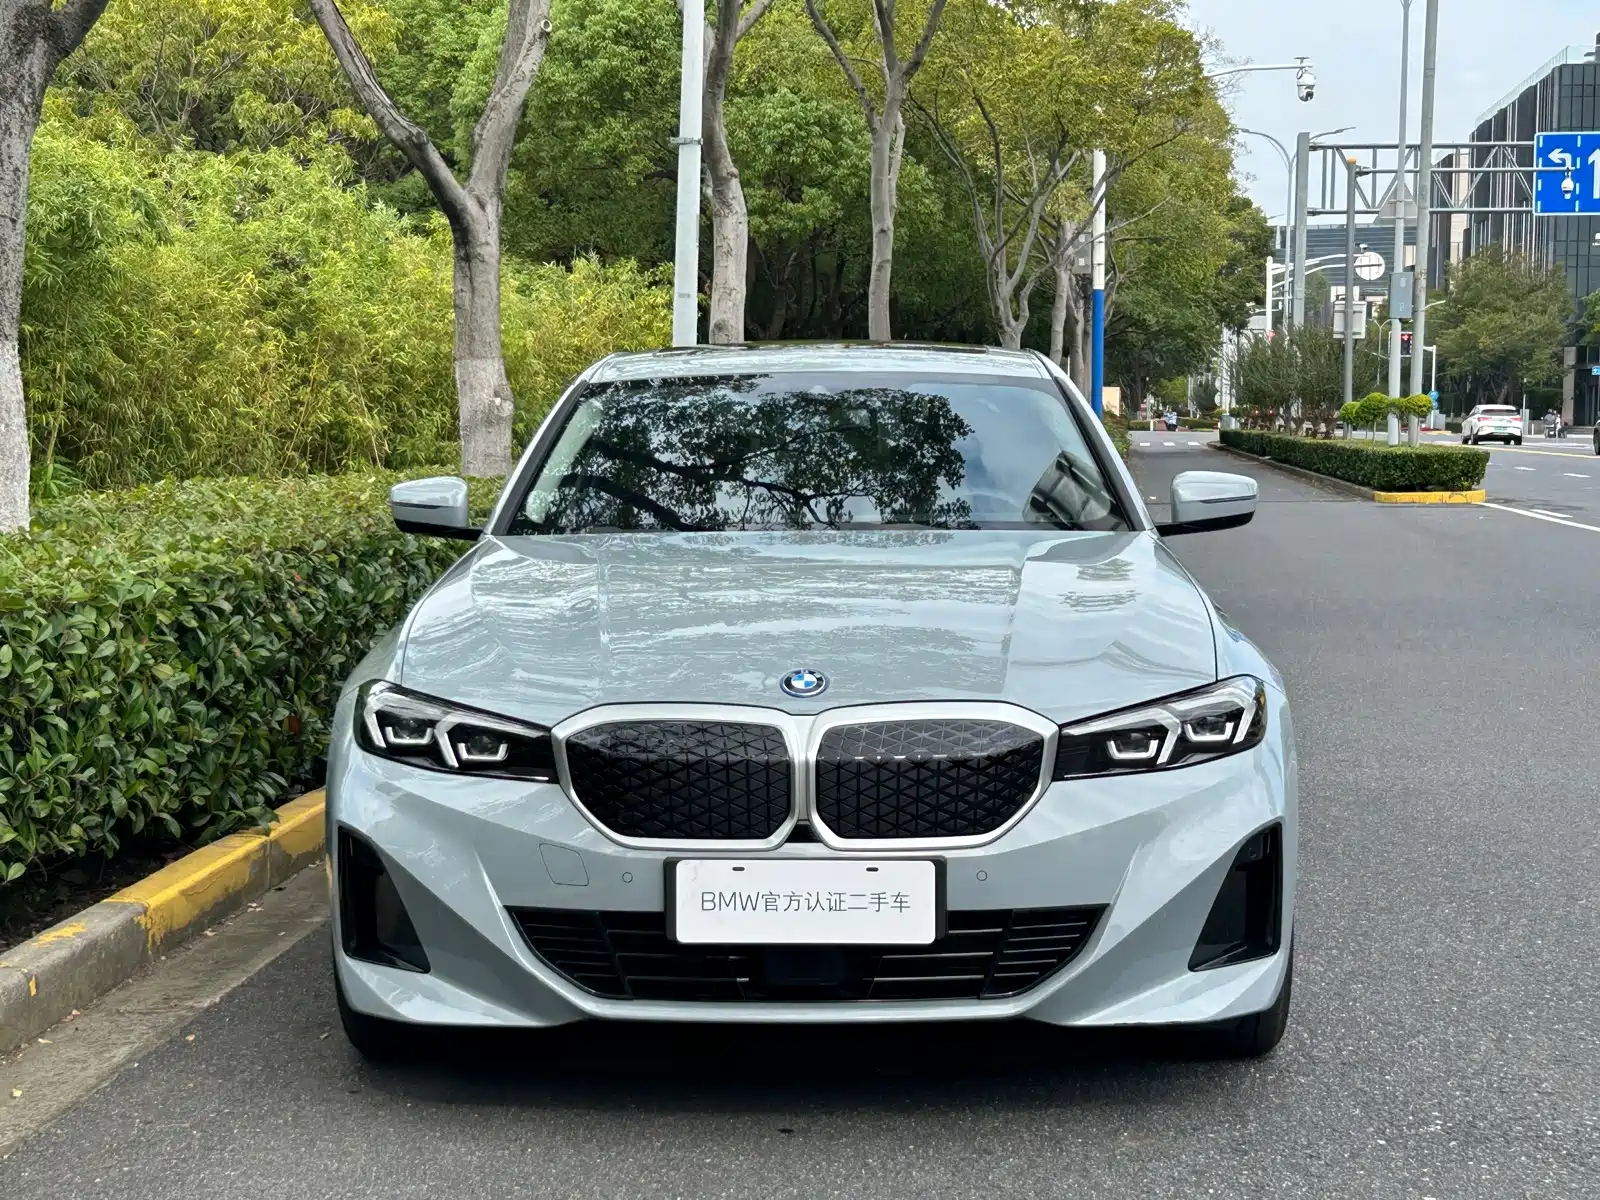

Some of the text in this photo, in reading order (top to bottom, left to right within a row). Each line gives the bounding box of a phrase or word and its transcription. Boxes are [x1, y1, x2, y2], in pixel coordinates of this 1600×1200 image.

[701, 891, 911, 913] BMW官方认证二手车
